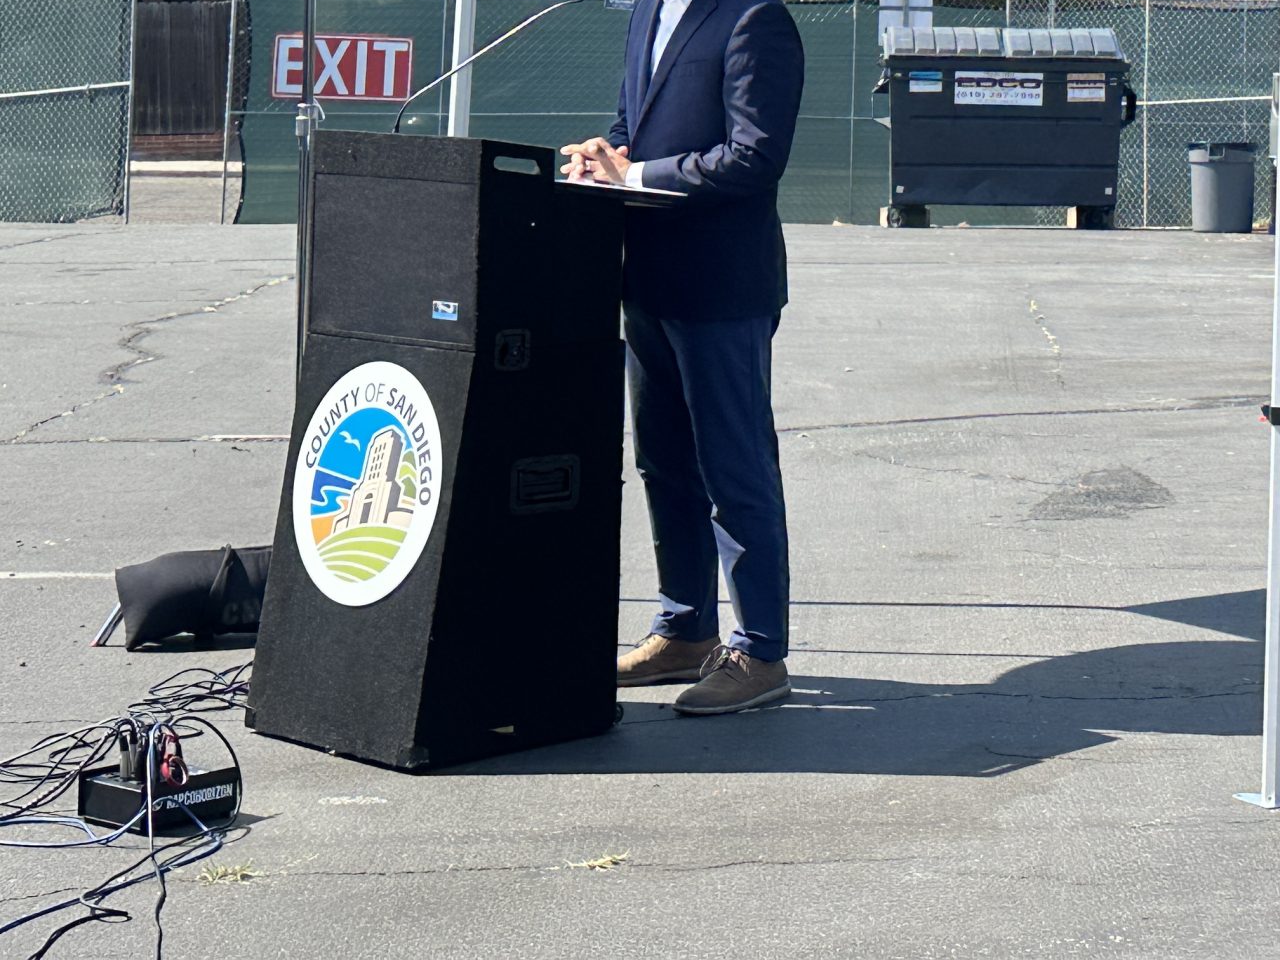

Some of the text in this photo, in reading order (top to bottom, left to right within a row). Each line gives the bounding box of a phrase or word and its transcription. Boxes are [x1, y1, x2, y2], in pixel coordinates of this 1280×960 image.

[276, 38, 409, 97] EXIT
[305, 382, 433, 507] COUNTY OF SAN DIEGO
